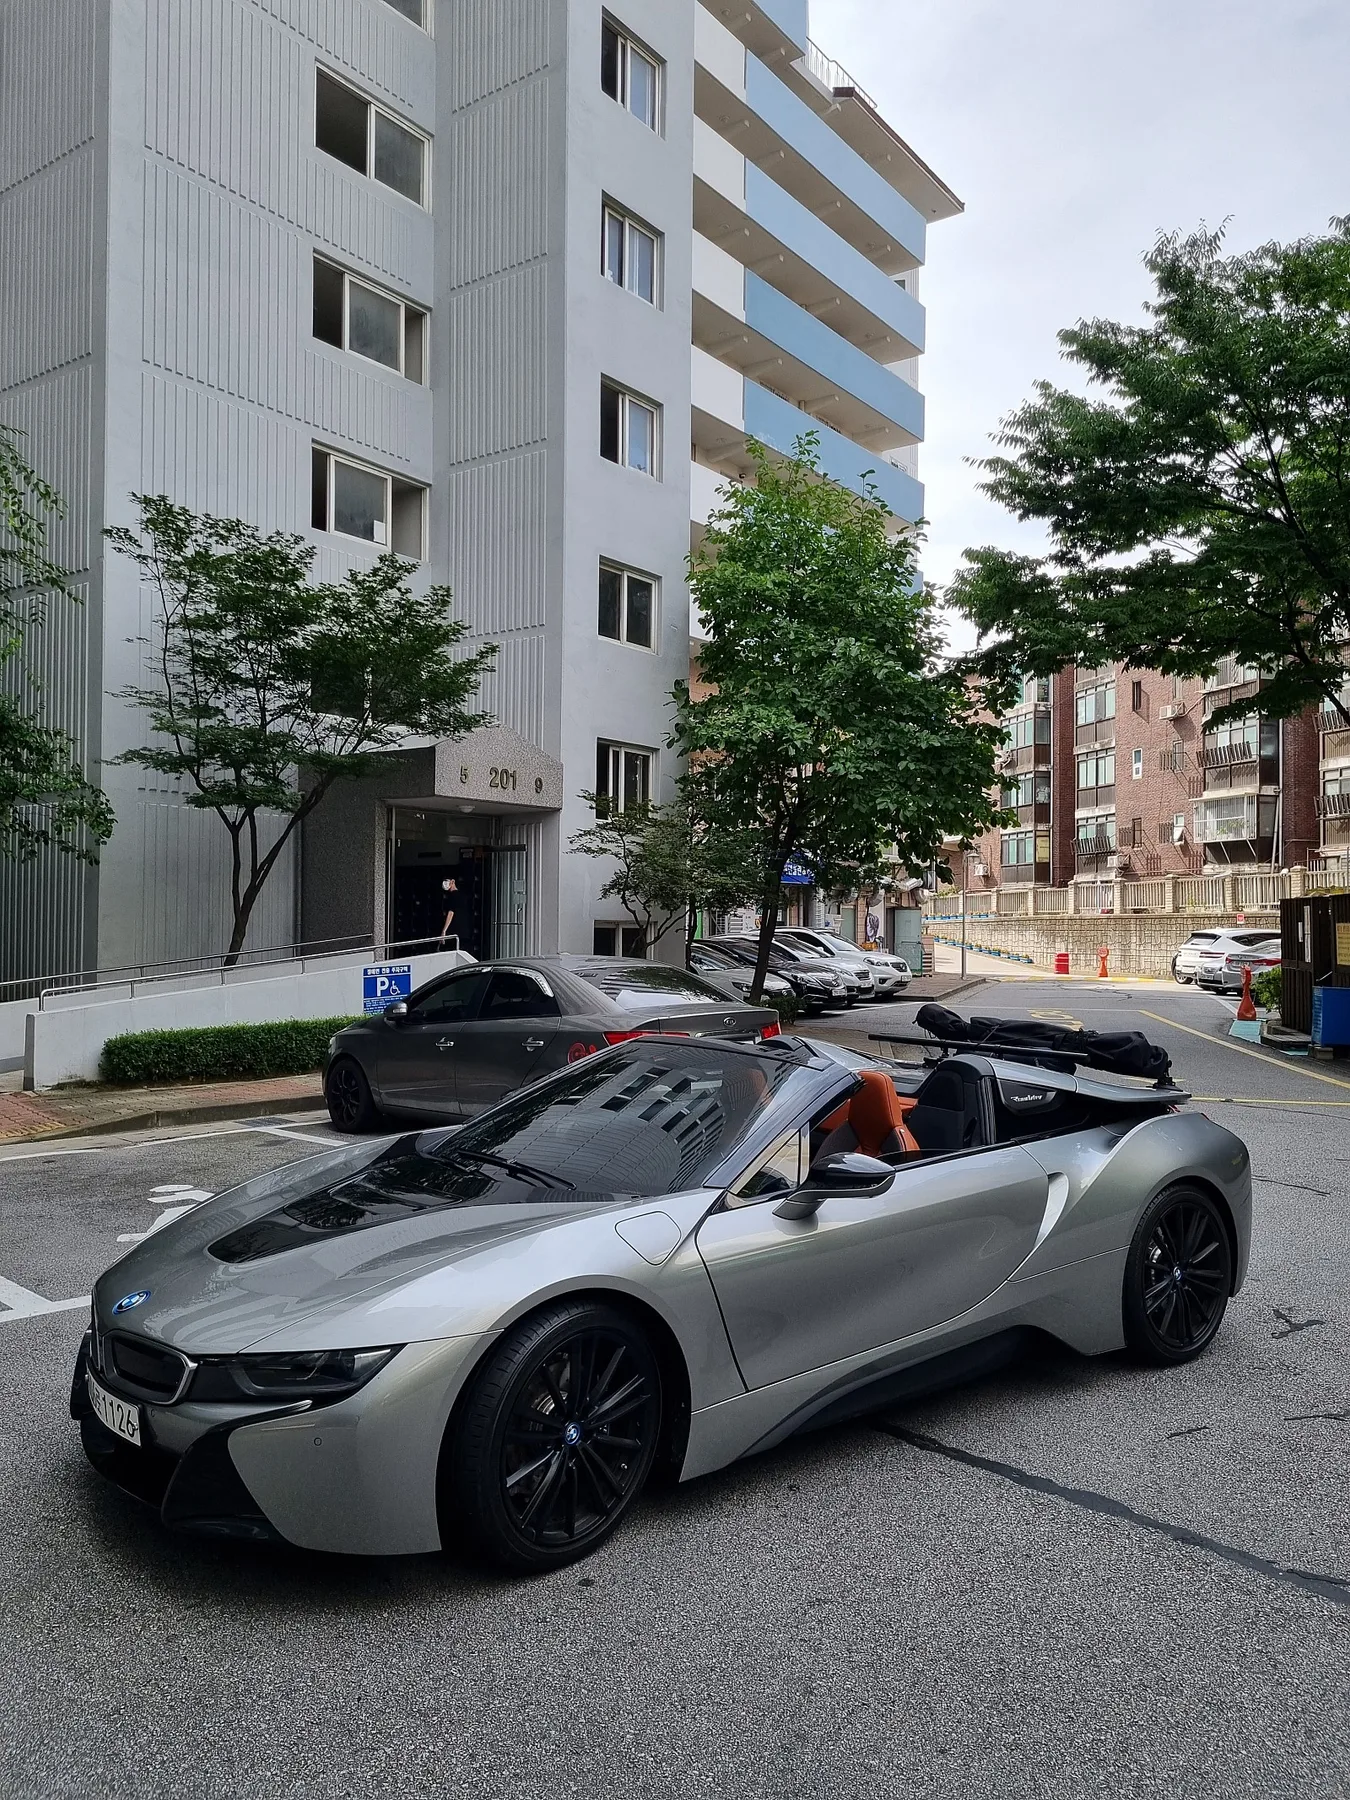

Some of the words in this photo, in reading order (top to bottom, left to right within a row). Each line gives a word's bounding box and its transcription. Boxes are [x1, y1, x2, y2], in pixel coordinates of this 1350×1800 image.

[460, 765, 469, 784] 5
[489, 766, 518, 791] 201
[534, 776, 543, 794] 9
[376, 976, 389, 997] P
[102, 1394, 139, 1438] 1126
